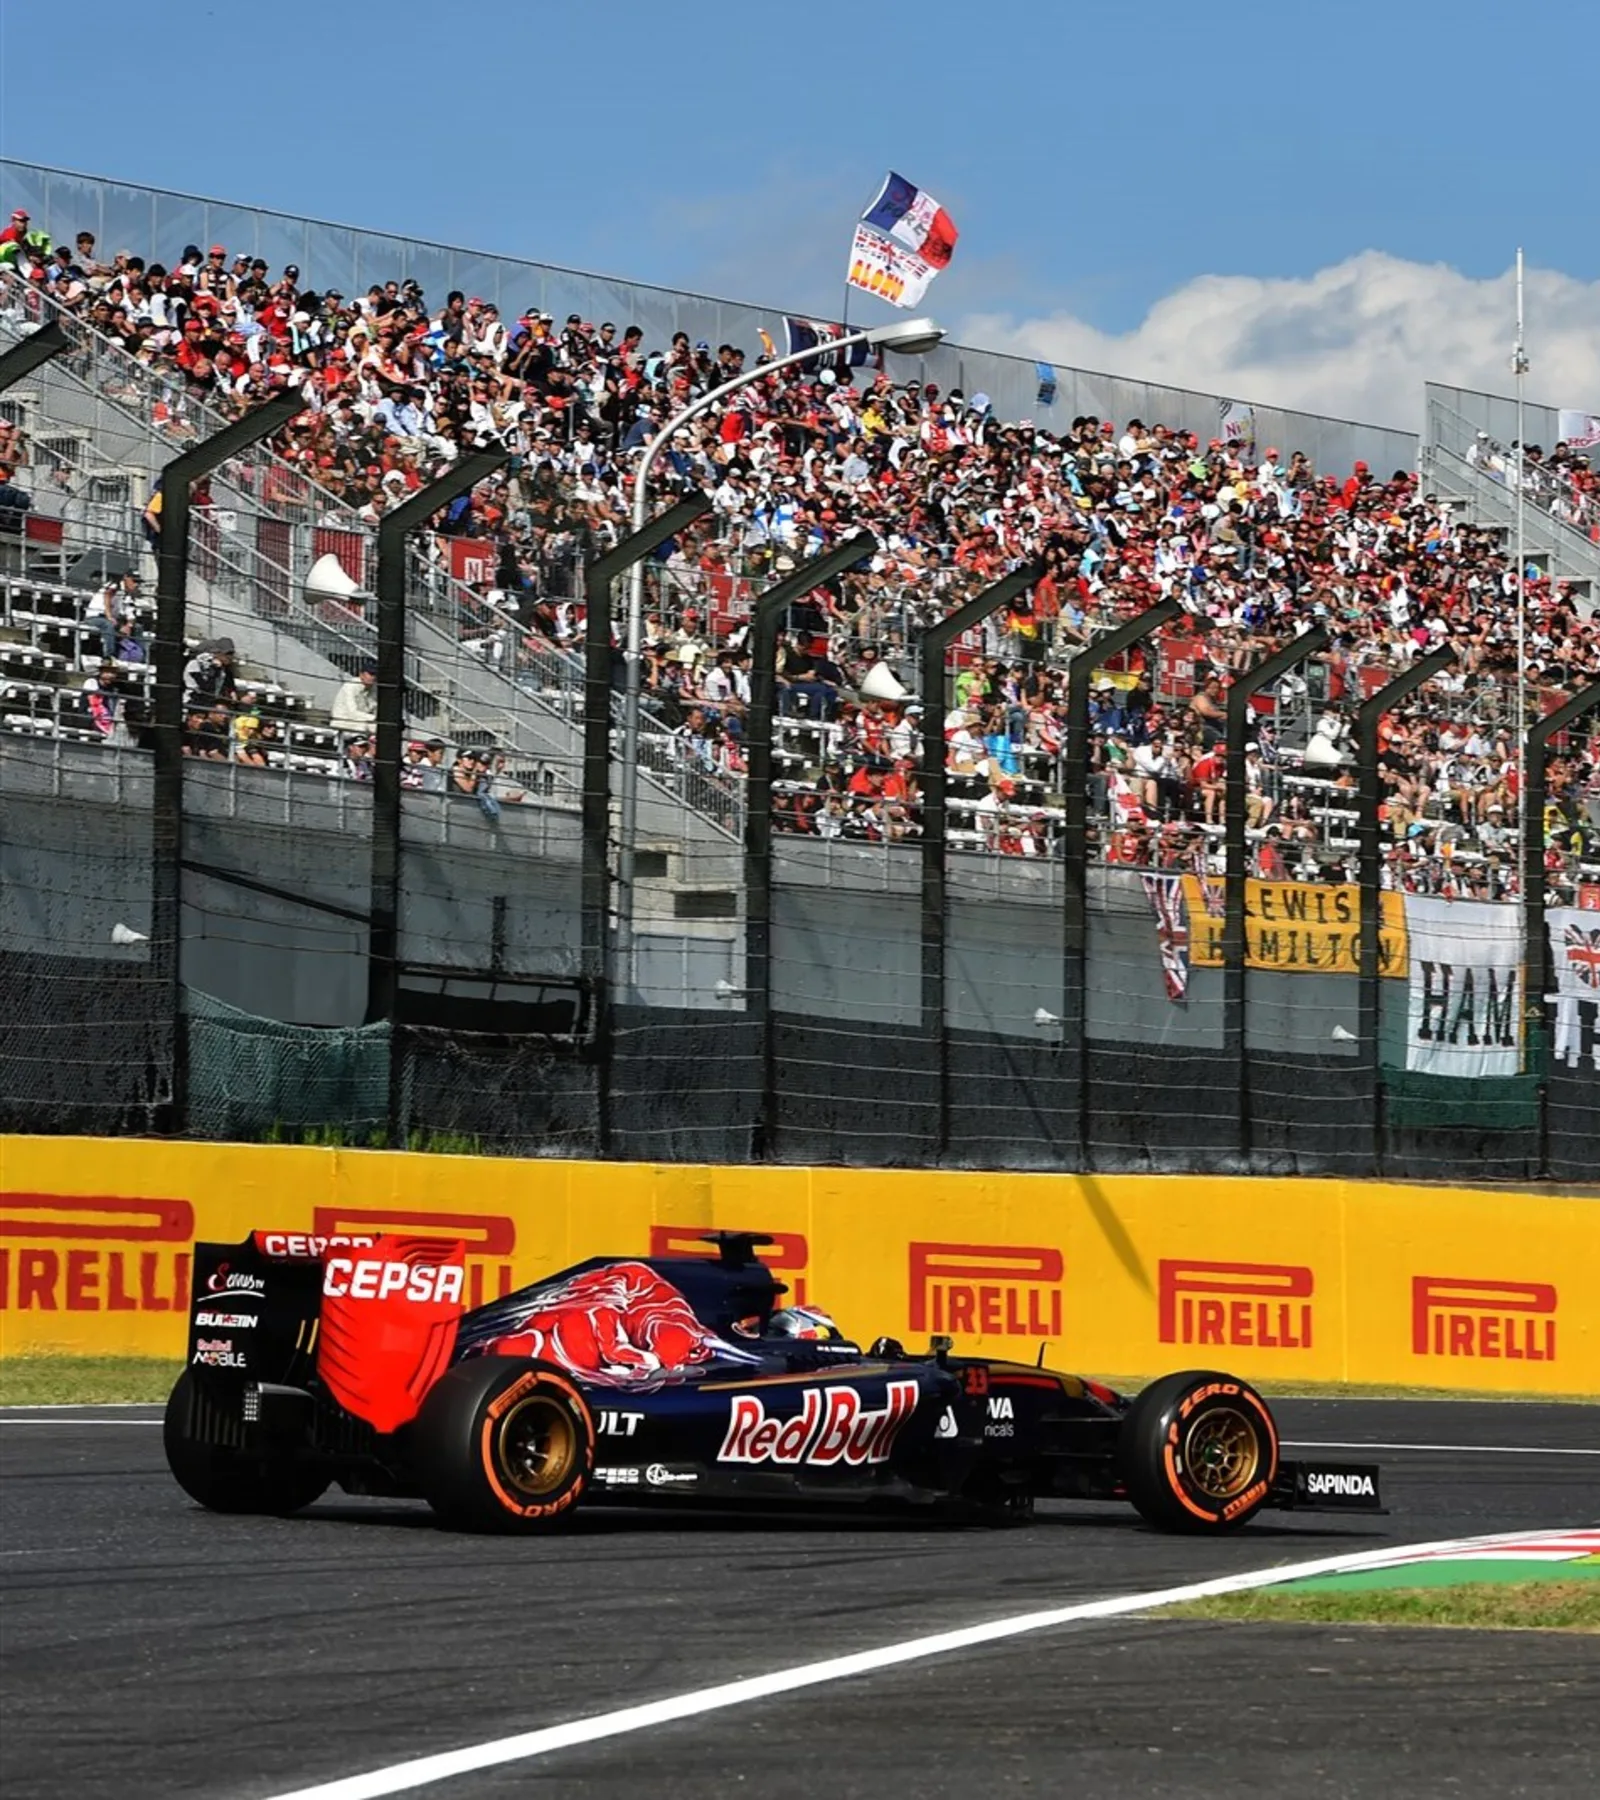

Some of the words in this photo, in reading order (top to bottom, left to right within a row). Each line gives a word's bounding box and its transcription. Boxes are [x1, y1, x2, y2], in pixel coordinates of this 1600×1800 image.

[1244, 888, 1351, 924] EWIS
[1208, 927, 1392, 971] HMILTON
[1418, 961, 1516, 1047] HAM
[323, 1258, 464, 1304] CEPSA
[908, 1241, 1063, 1337] PIRELLI
[1159, 1258, 1314, 1349] PIRELLI
[1412, 1275, 1557, 1361] PIRELLI
[717, 1388, 821, 1464] Red
[806, 1380, 919, 1465] Bull
[1180, 1383, 1241, 1419] ZERO
[1308, 1473, 1375, 1496] SAPINDA
